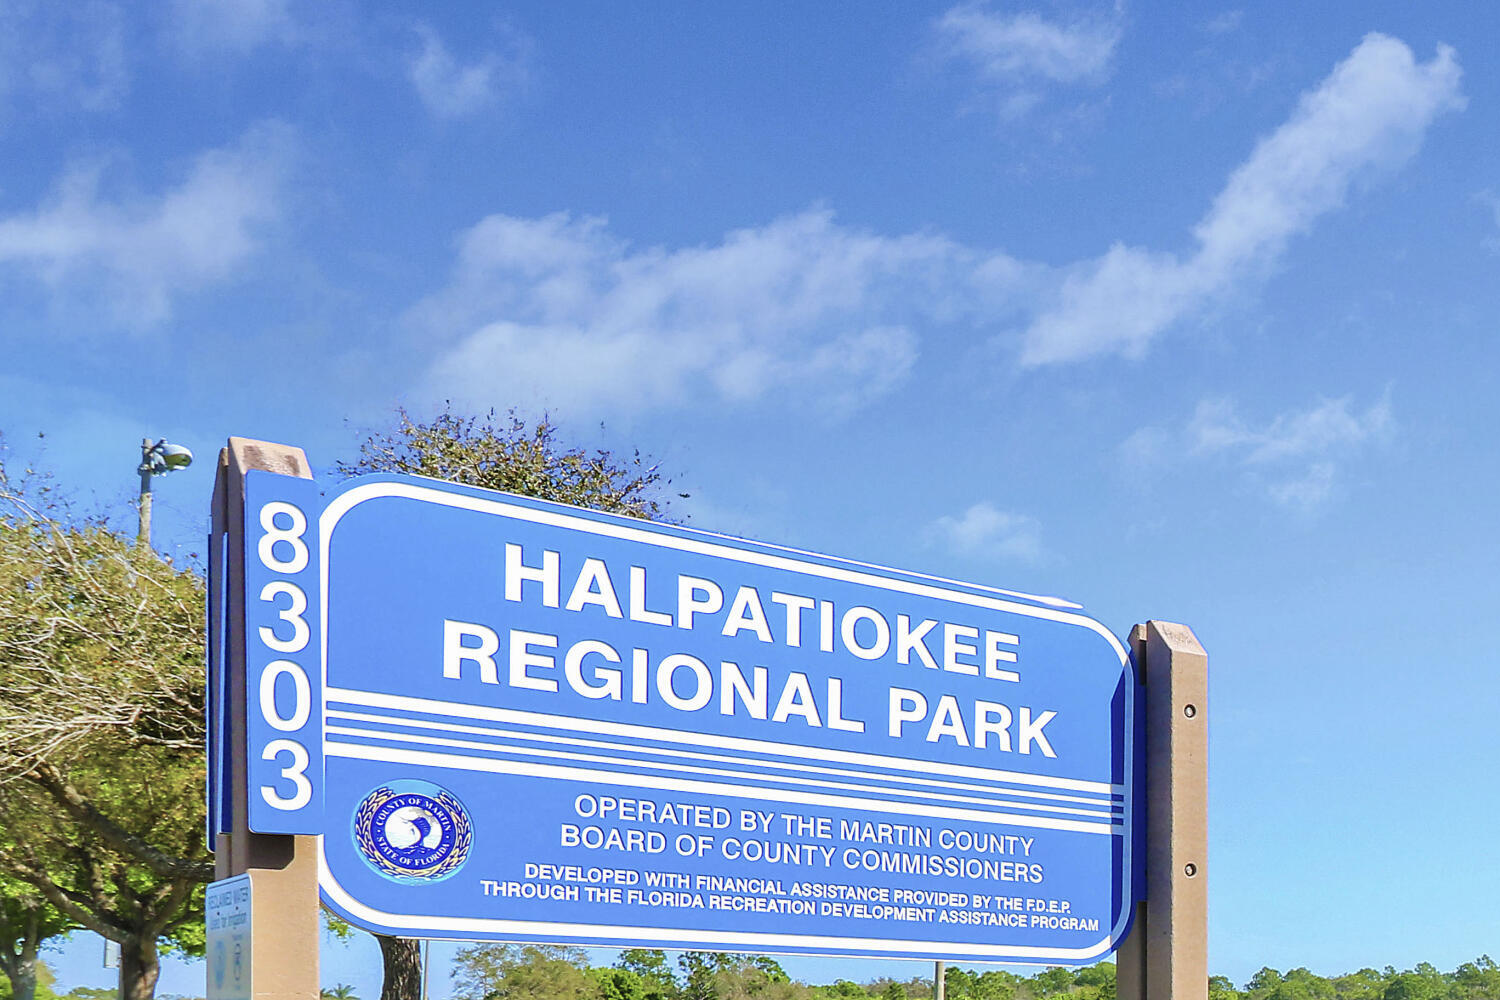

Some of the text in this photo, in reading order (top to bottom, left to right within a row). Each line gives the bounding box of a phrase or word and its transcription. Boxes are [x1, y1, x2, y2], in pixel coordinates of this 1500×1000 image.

[505, 543, 1020, 683] HALPATIOKEE
[258, 501, 312, 811] 8303
[443, 619, 1057, 758] REGIONAL PARK
[376, 798, 451, 831] COUNTY OF MARTIN
[574, 794, 1034, 856] OPERATED BY THE MARTIN COUNTY
[377, 836, 449, 866] STATE OF FLORIDA
[561, 824, 1043, 884] BOARD OF COUNTY COMMISSIONERS
[480, 880, 1099, 931] THROUGH THE FLORIDA RECREATION DEVELOPMENT ASSISTANCE PROGRAM
[525, 863, 1071, 914] DEVELOPED WITH FINANCIAL ASSISTANCE PROVIDED BY THE F.D.E.P.
